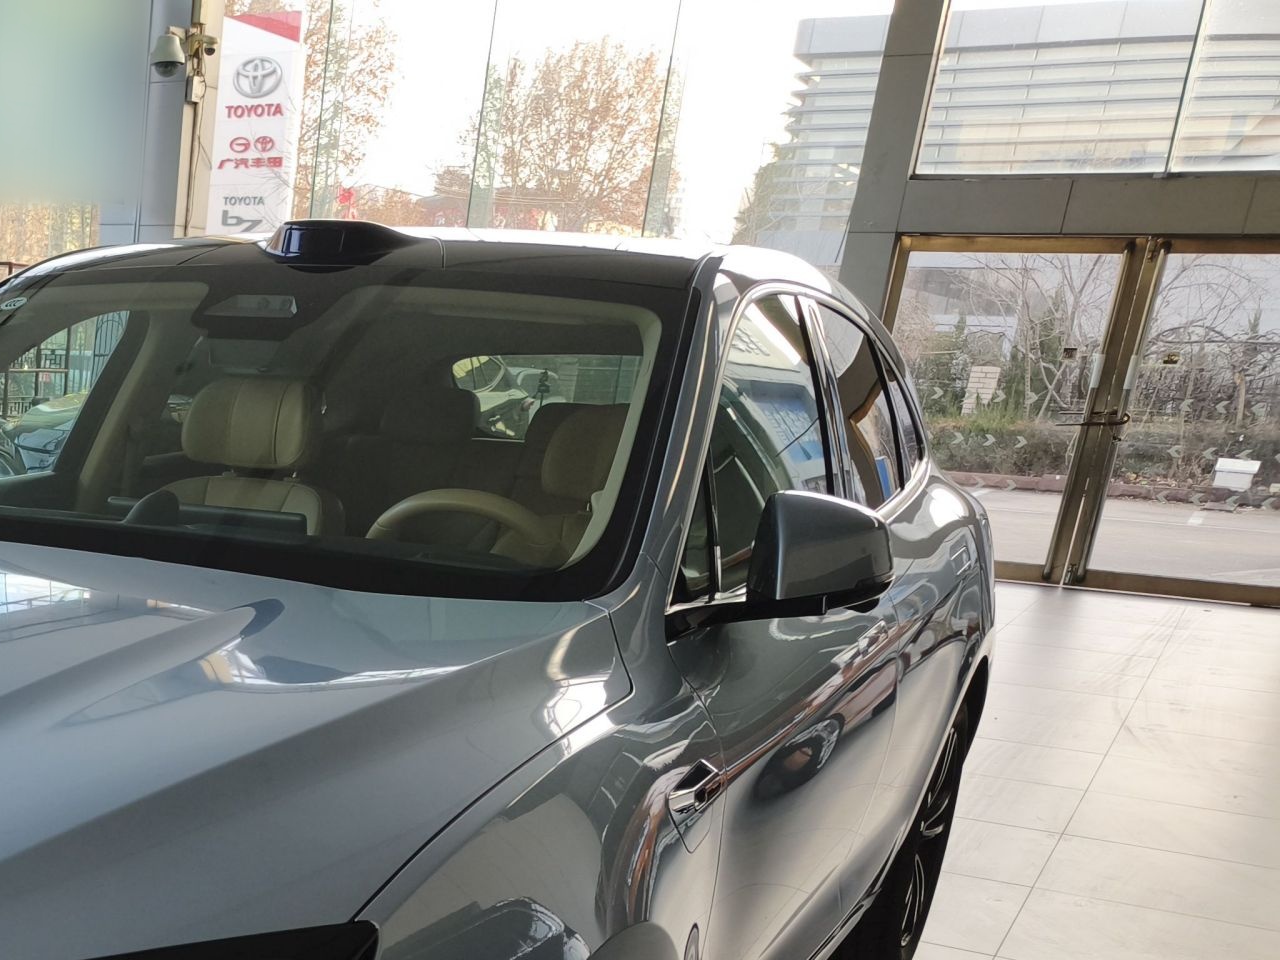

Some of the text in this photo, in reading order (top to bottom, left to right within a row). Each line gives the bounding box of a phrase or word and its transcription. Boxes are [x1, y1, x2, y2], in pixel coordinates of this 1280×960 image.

[225, 104, 284, 118] TOYOTA
[218, 157, 283, 169] 广汽丰田
[223, 196, 265, 206] TOYOTA
